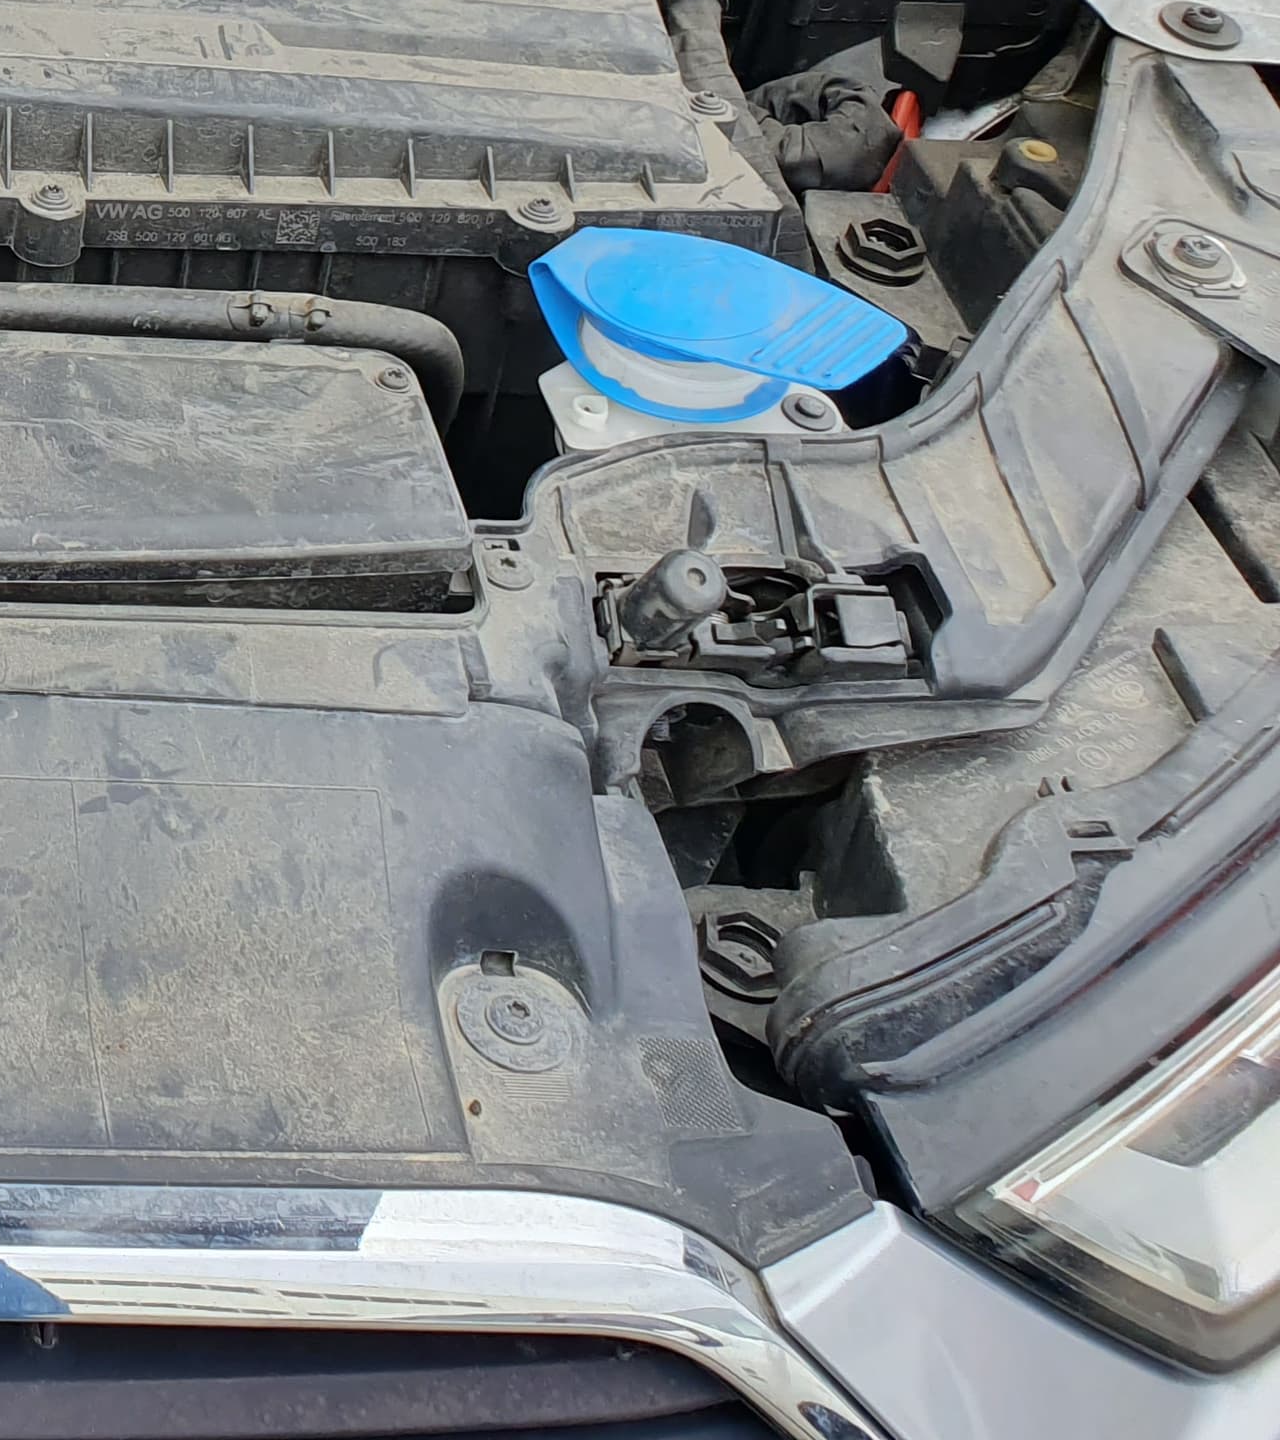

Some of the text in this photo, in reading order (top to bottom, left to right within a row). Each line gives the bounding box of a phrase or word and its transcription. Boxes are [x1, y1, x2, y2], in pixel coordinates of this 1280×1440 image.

[95, 203, 129, 219] VW
[132, 204, 163, 220] AG
[167, 232, 186, 243] 129
